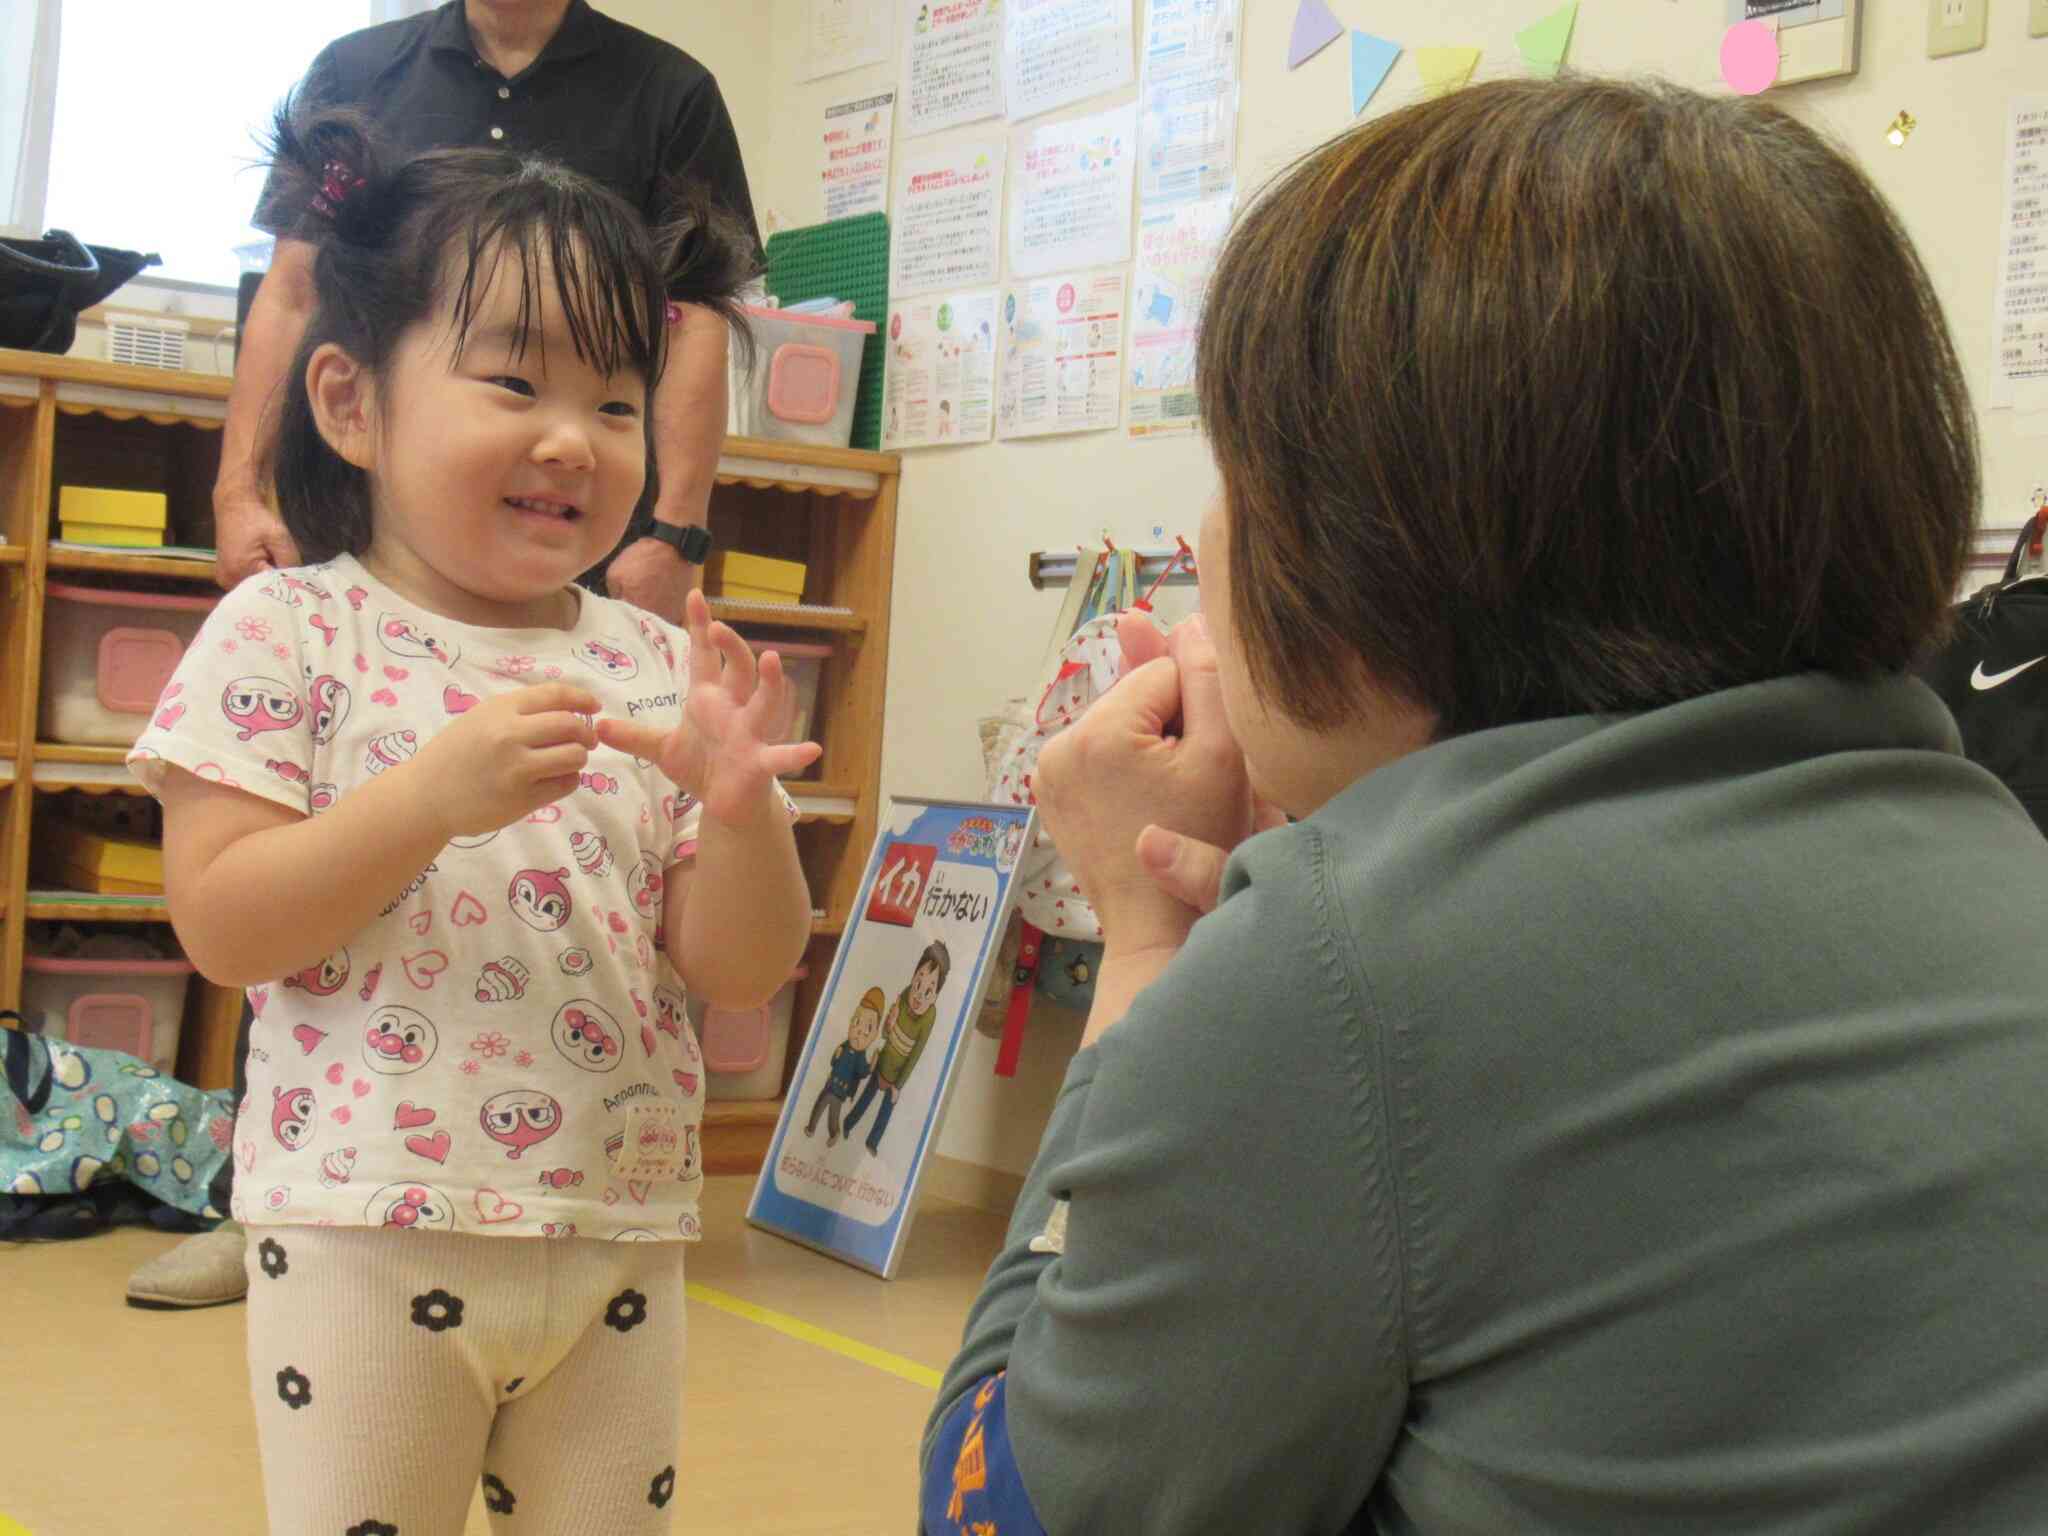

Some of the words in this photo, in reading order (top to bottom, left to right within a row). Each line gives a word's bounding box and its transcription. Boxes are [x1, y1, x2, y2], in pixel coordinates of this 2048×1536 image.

[879, 856, 921, 909] イカ
[922, 886, 989, 922] 行かない
